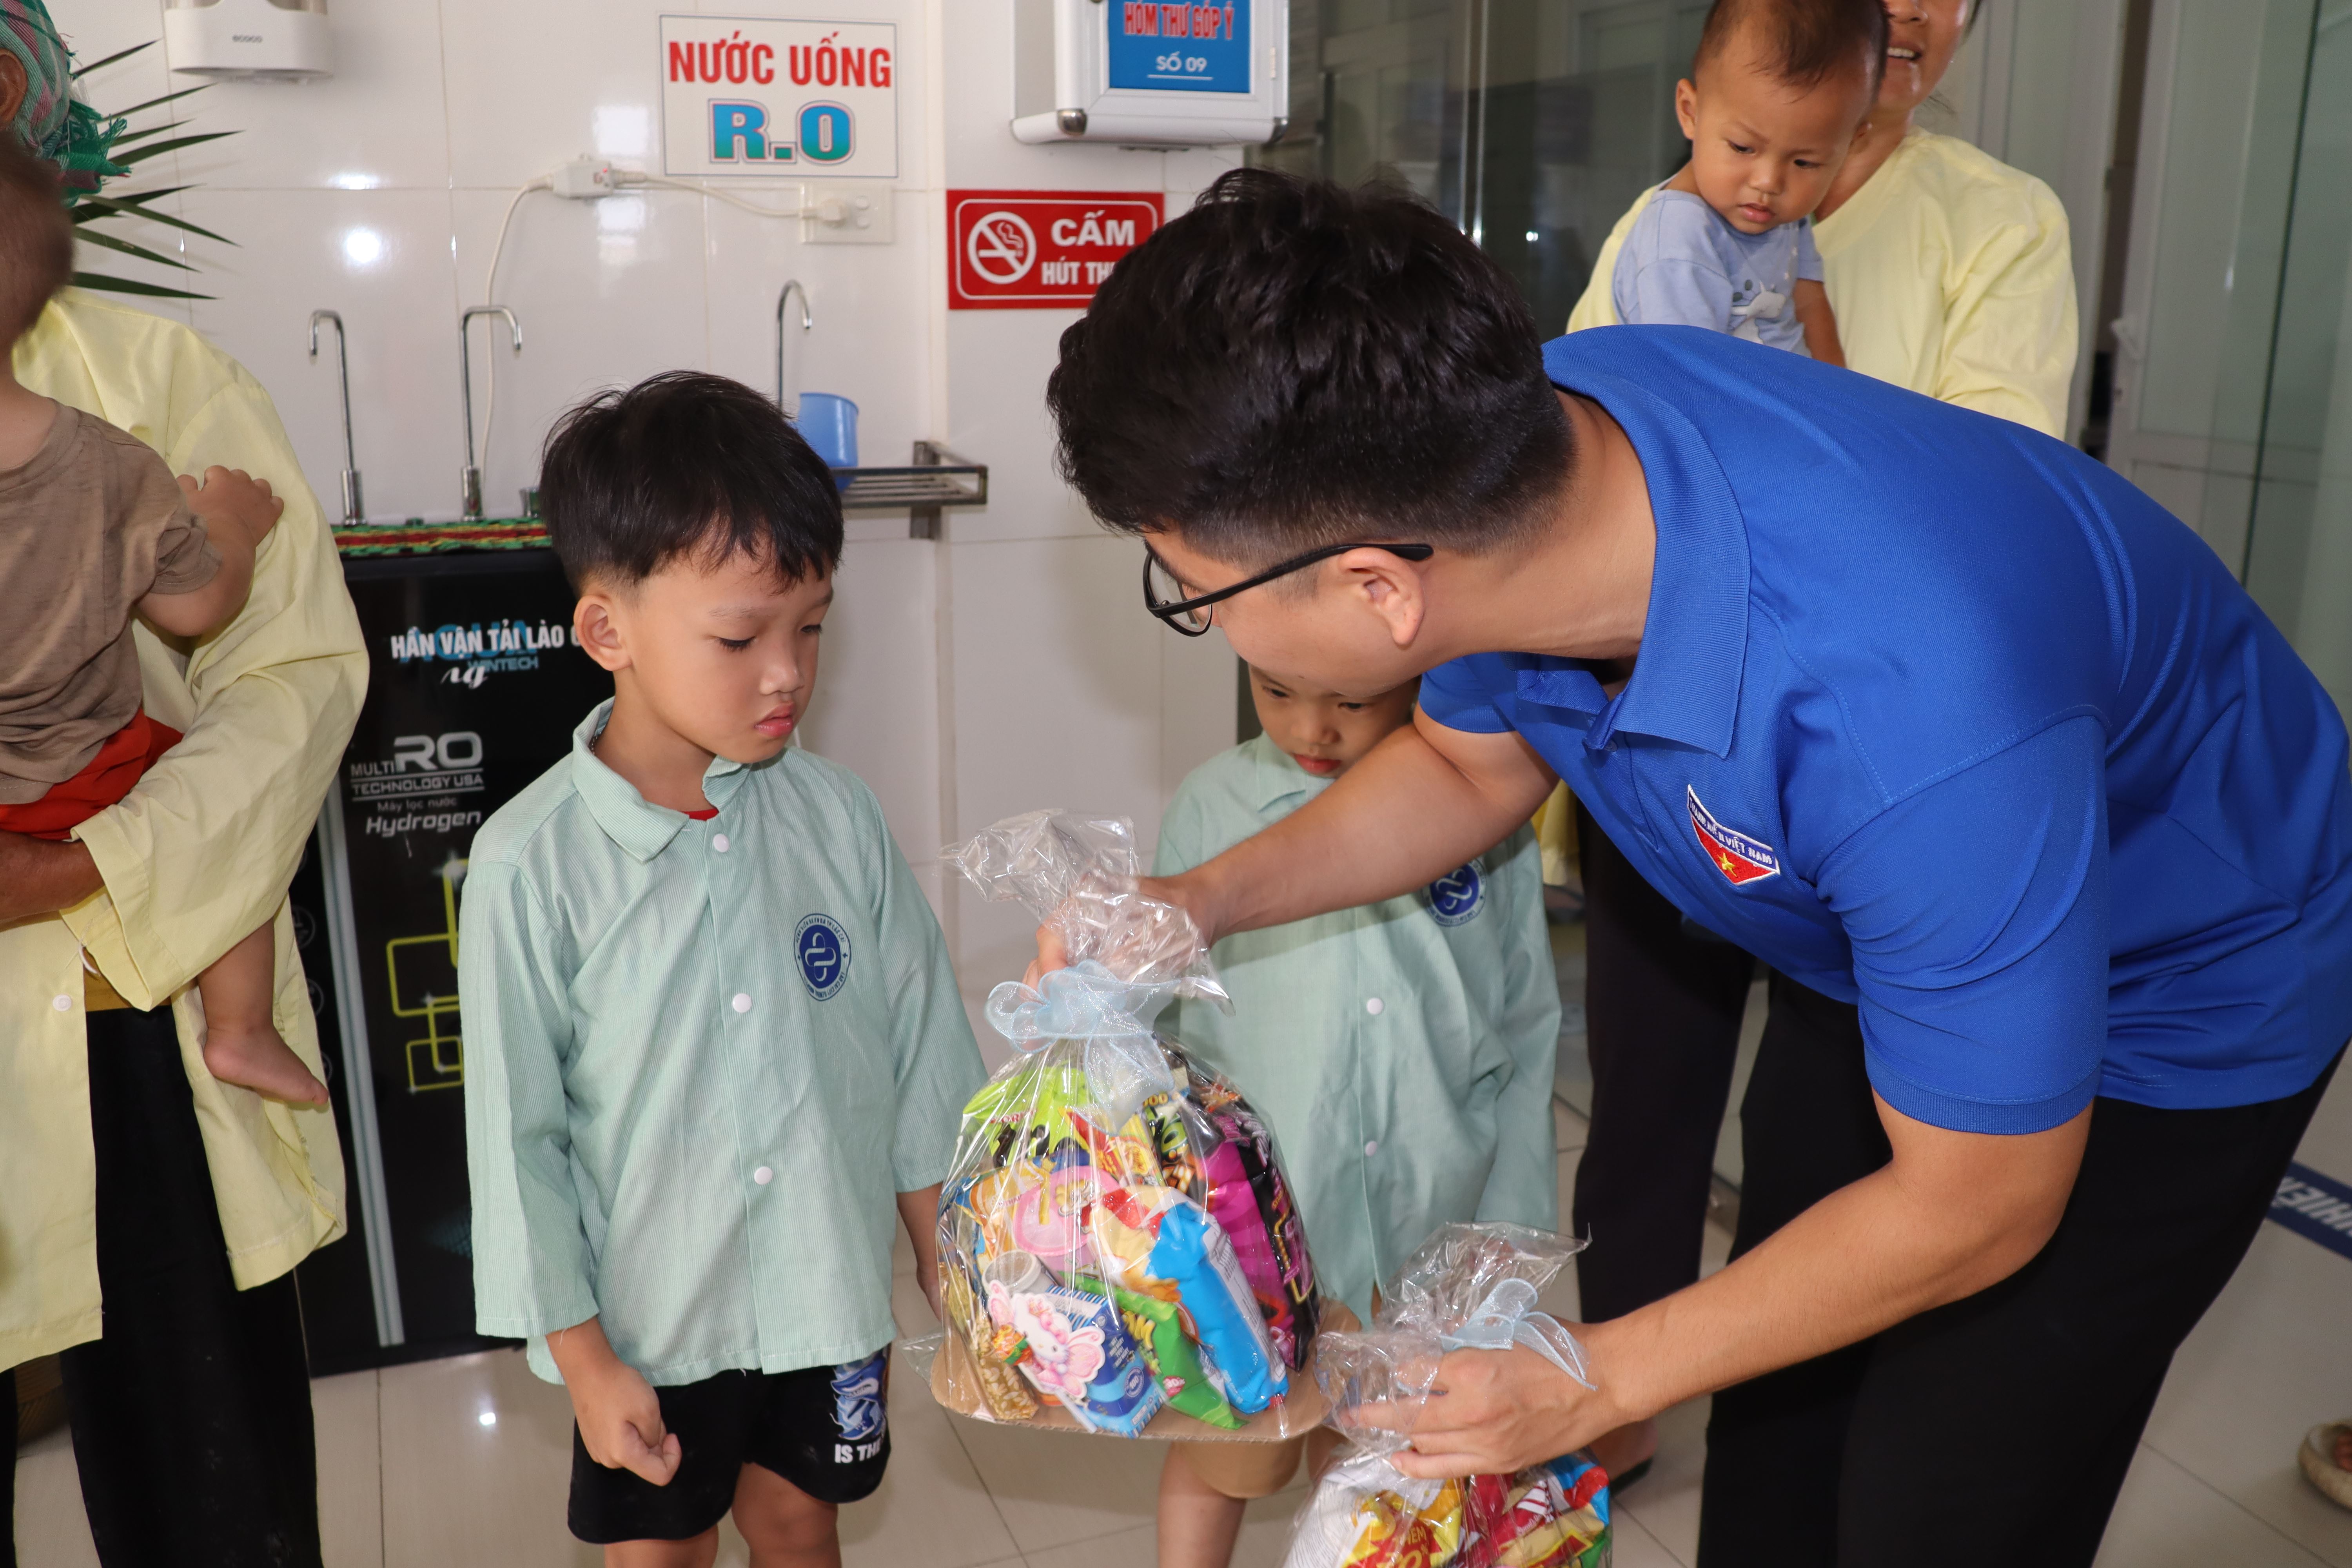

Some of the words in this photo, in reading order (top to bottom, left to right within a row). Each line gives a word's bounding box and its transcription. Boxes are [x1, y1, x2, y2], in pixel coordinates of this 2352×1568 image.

[1224, 0, 1234, 40] Ý
[669, 30, 775, 85] NƯỚC
[789, 31, 891, 88] UỐNG
[1156, 51, 1182, 71] SỐ
[1185, 57, 1207, 72] 09
[709, 99, 855, 165] R.O
[1051, 210, 1135, 247] CẤM
[1041, 256, 1081, 285] HÚT
[440, 626, 483, 659] VẬN
[487, 619, 521, 652] TẢI
[526, 619, 564, 649] LÀO
[394, 731, 483, 772] RO
[350, 760, 394, 777] MULTI
[352, 777, 451, 796] TECHNOLOGY
[453, 773, 483, 787] USA
[365, 810, 482, 838] Hydrogen
[1725, 836, 1746, 854] VIỆT
[1748, 847, 1773, 865] NAM
[835, 1444, 853, 1463] IS
